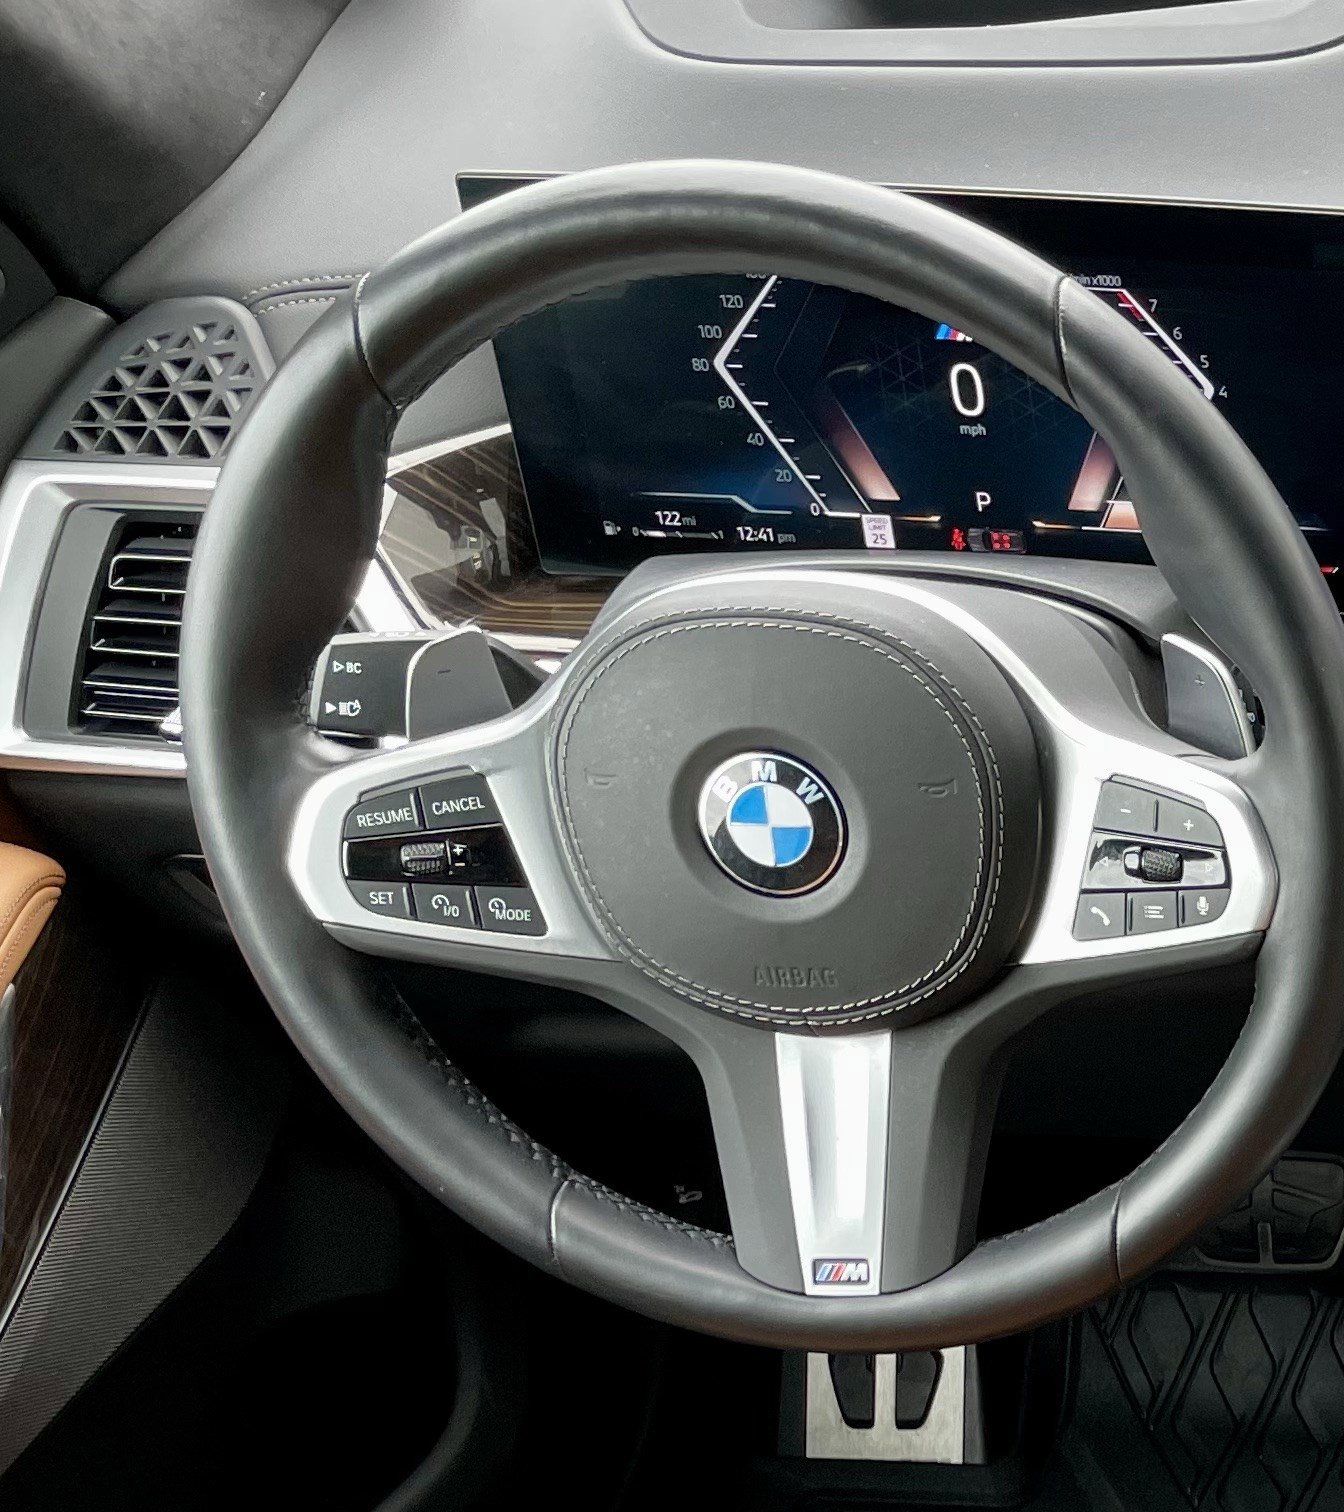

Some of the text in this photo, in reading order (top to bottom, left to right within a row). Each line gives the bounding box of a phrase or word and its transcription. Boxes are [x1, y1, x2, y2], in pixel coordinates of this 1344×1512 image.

[719, 294, 743, 309] 120
[1149, 299, 1158, 313] 7
[697, 325, 722, 339] 100
[1172, 326, 1183, 340] 6
[692, 358, 710, 372] 80
[1200, 355, 1210, 369] 5
[950, 363, 985, 417] 0
[1218, 385, 1228, 399] 4
[718, 396, 735, 410] 60
[959, 424, 987, 437] mph
[747, 433, 764, 446] 40
[775, 469, 792, 483] 20
[975, 491, 991, 511] P
[810, 503, 820, 516] 0
[736, 526, 796, 544] 12:41 pm
[867, 524, 887, 532] LIMIT
[872, 533, 888, 545] 25
[346, 662, 362, 674] BC
[712, 760, 825, 805] BMW
[432, 796, 485, 816] CANCEL
[357, 807, 414, 828] RESUME
[369, 891, 393, 905] SET
[443, 905, 460, 918] I/O
[495, 907, 531, 922] MODE
[755, 964, 839, 989] AIRBAG
